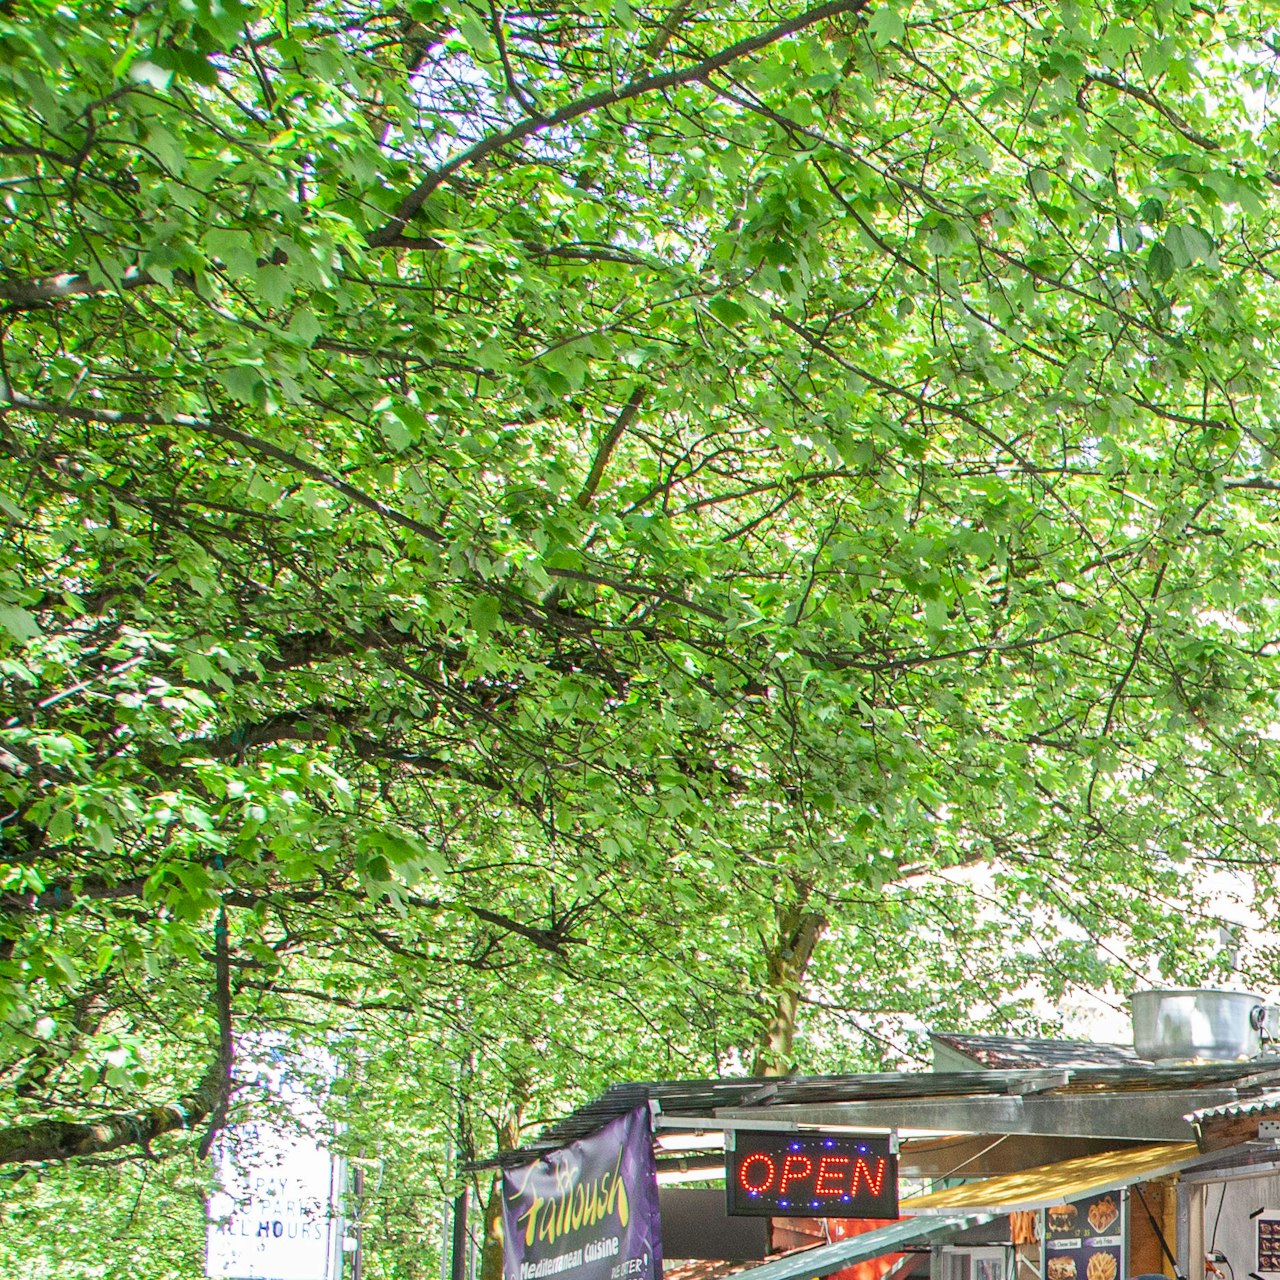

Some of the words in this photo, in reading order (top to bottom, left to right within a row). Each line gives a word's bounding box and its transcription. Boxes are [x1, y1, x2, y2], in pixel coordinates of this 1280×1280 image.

[739, 1153, 886, 1198] OPEN
[521, 1249, 582, 1280] Mediterranean
[585, 1237, 619, 1263] Cuisine
